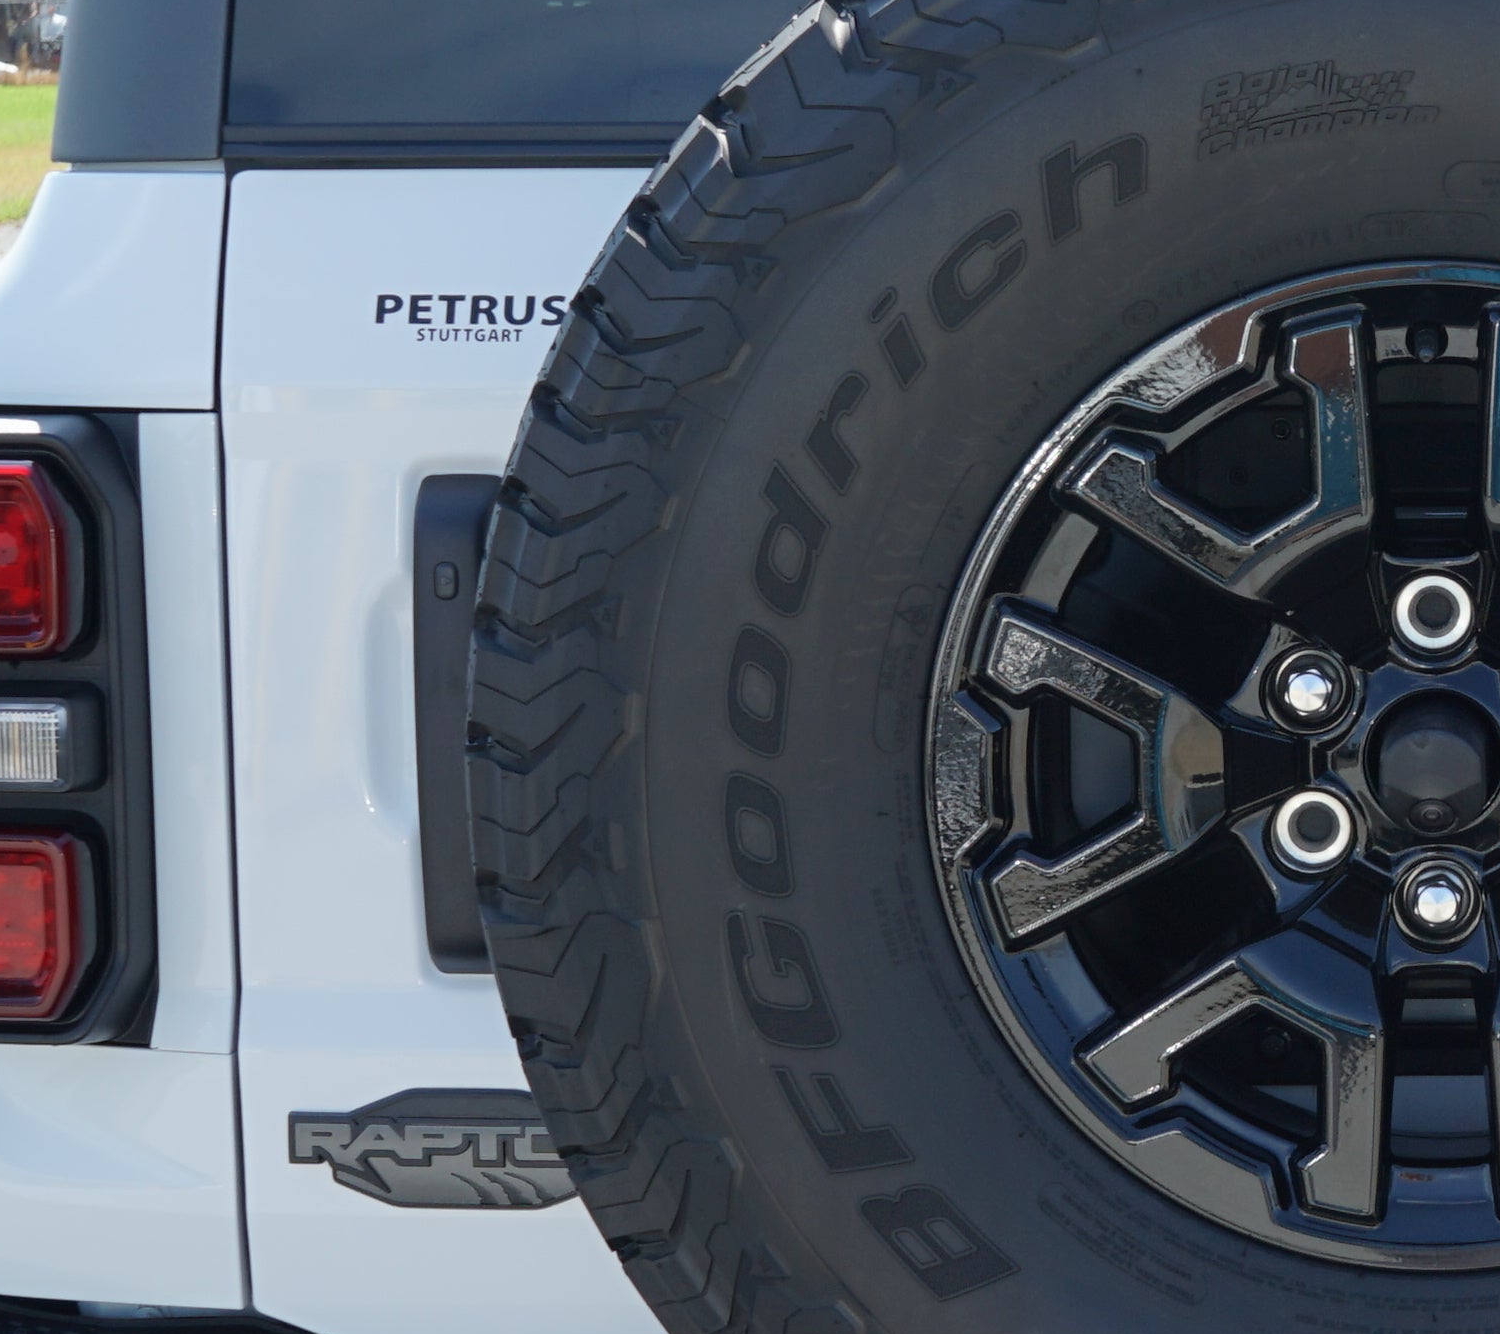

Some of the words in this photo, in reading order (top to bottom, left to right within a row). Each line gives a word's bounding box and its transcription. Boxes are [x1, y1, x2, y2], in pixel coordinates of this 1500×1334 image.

[1197, 104, 1441, 158] Champion
[375, 293, 566, 326] PETRUS
[415, 327, 524, 343] STUTTGART
[723, 131, 1149, 1303] BFGoodrich
[294, 1121, 562, 1173] RAPTO
